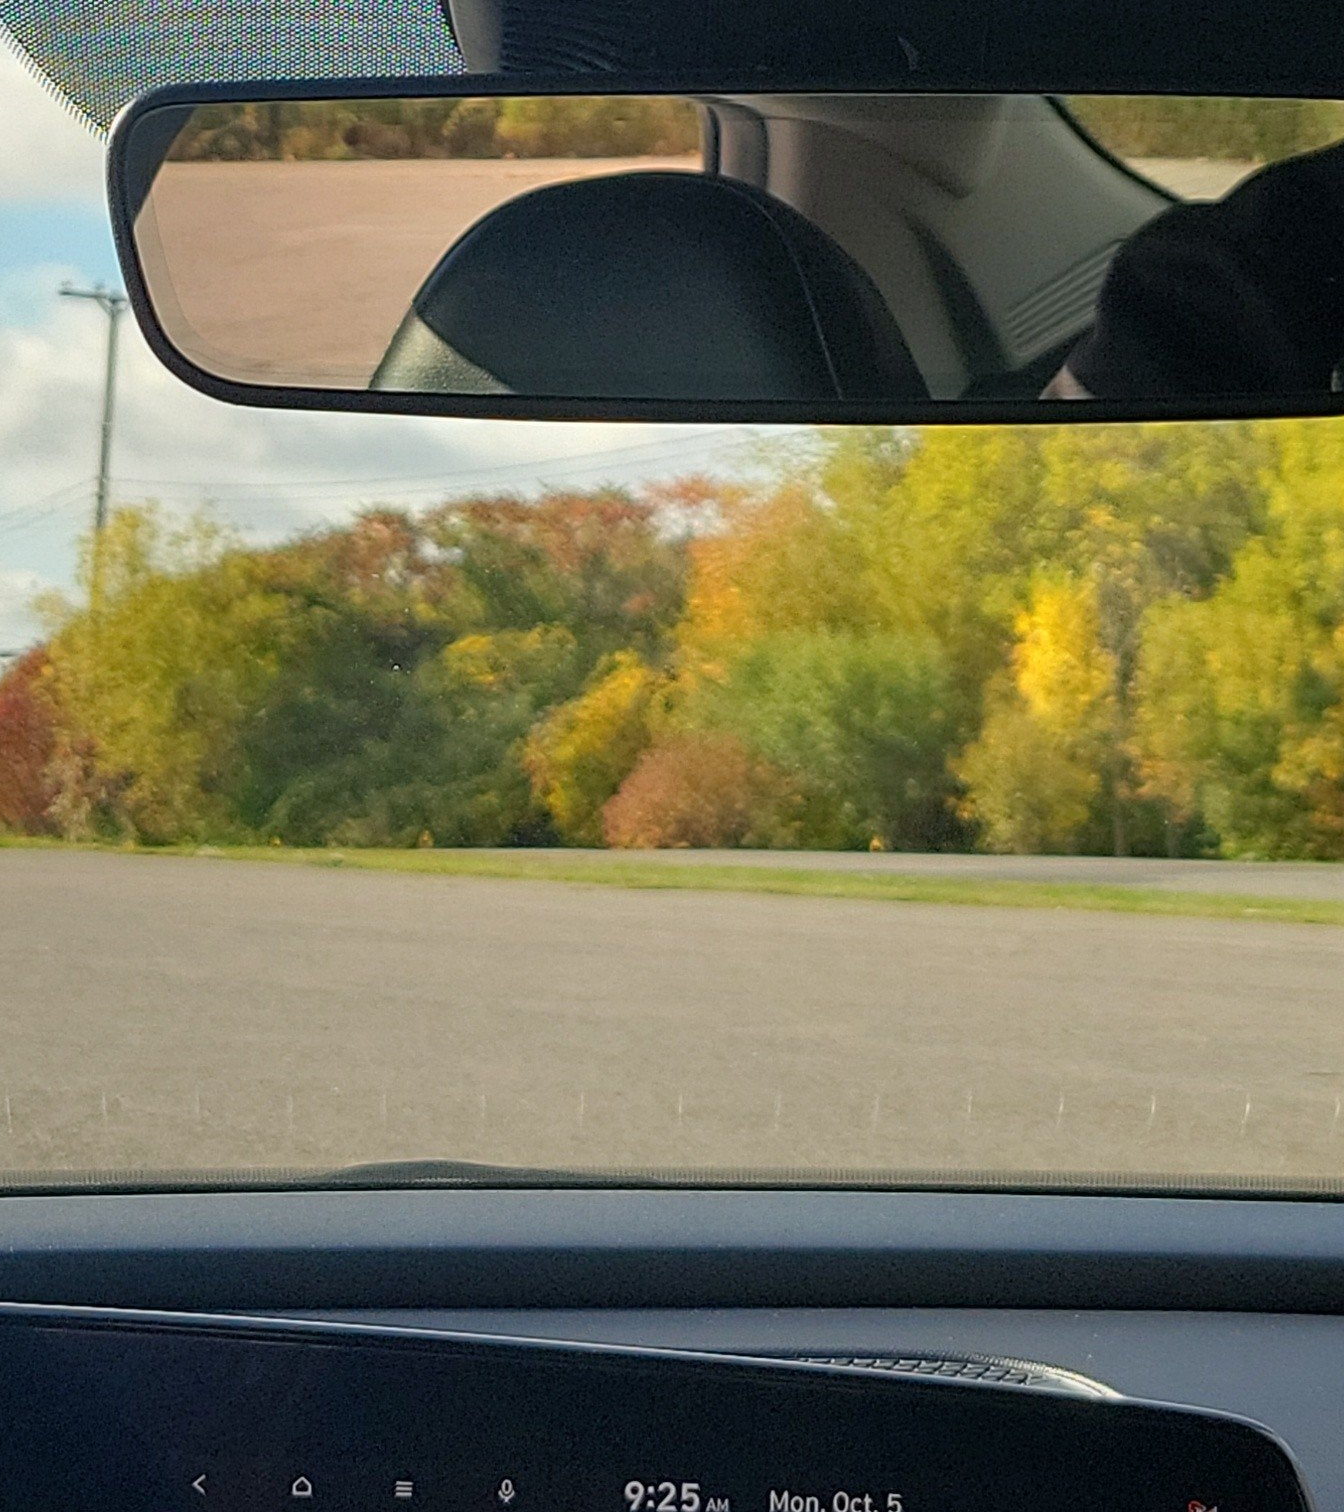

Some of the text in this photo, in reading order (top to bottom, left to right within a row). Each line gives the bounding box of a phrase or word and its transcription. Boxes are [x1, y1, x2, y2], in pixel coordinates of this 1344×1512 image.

[624, 1480, 701, 1512] 9:25
[705, 1497, 730, 1512] AM
[887, 1493, 902, 1512] 5
